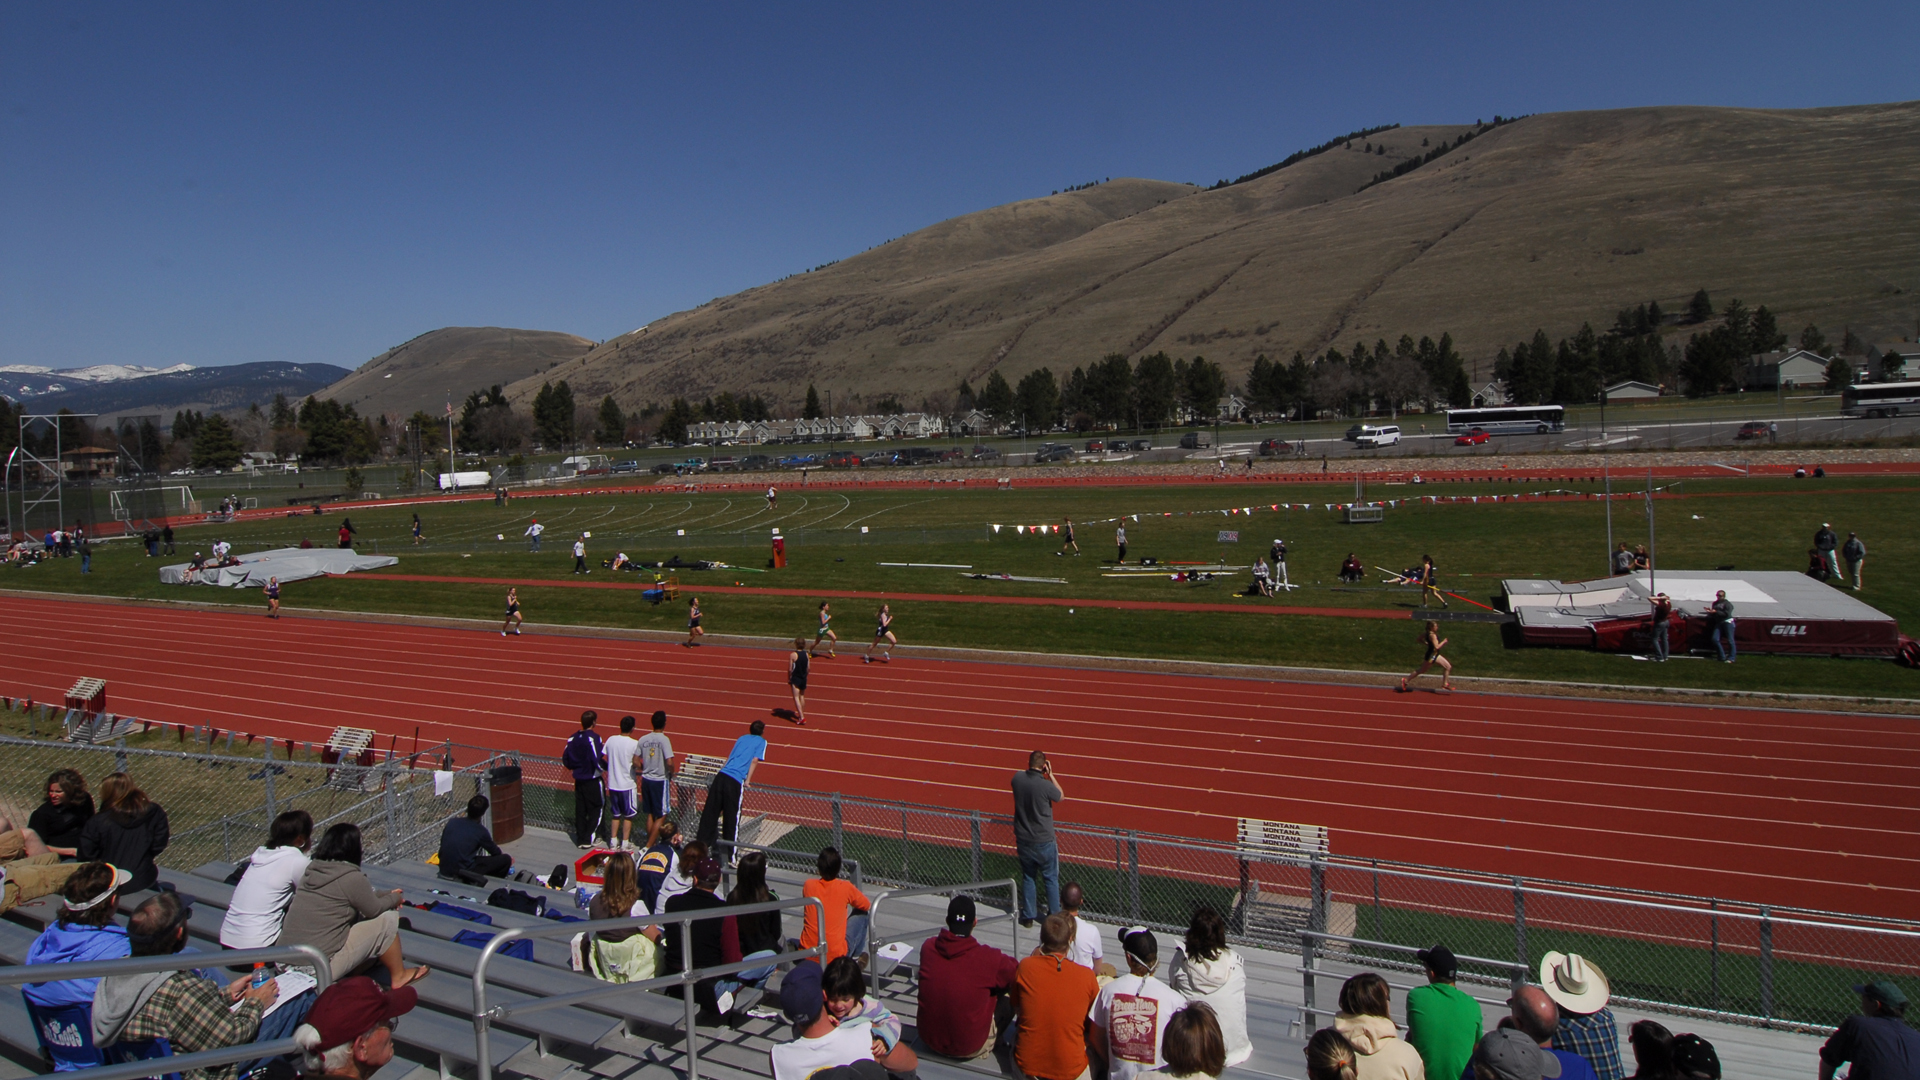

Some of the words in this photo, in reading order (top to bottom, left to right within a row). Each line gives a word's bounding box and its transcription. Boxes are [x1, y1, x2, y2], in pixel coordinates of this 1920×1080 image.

[1770, 625, 1807, 636] GILL
[1263, 821, 1301, 830] MONTANA
[1262, 827, 1301, 836] MONTANA
[1263, 833, 1302, 842] MONTANA
[1262, 839, 1301, 848] MONTANA
